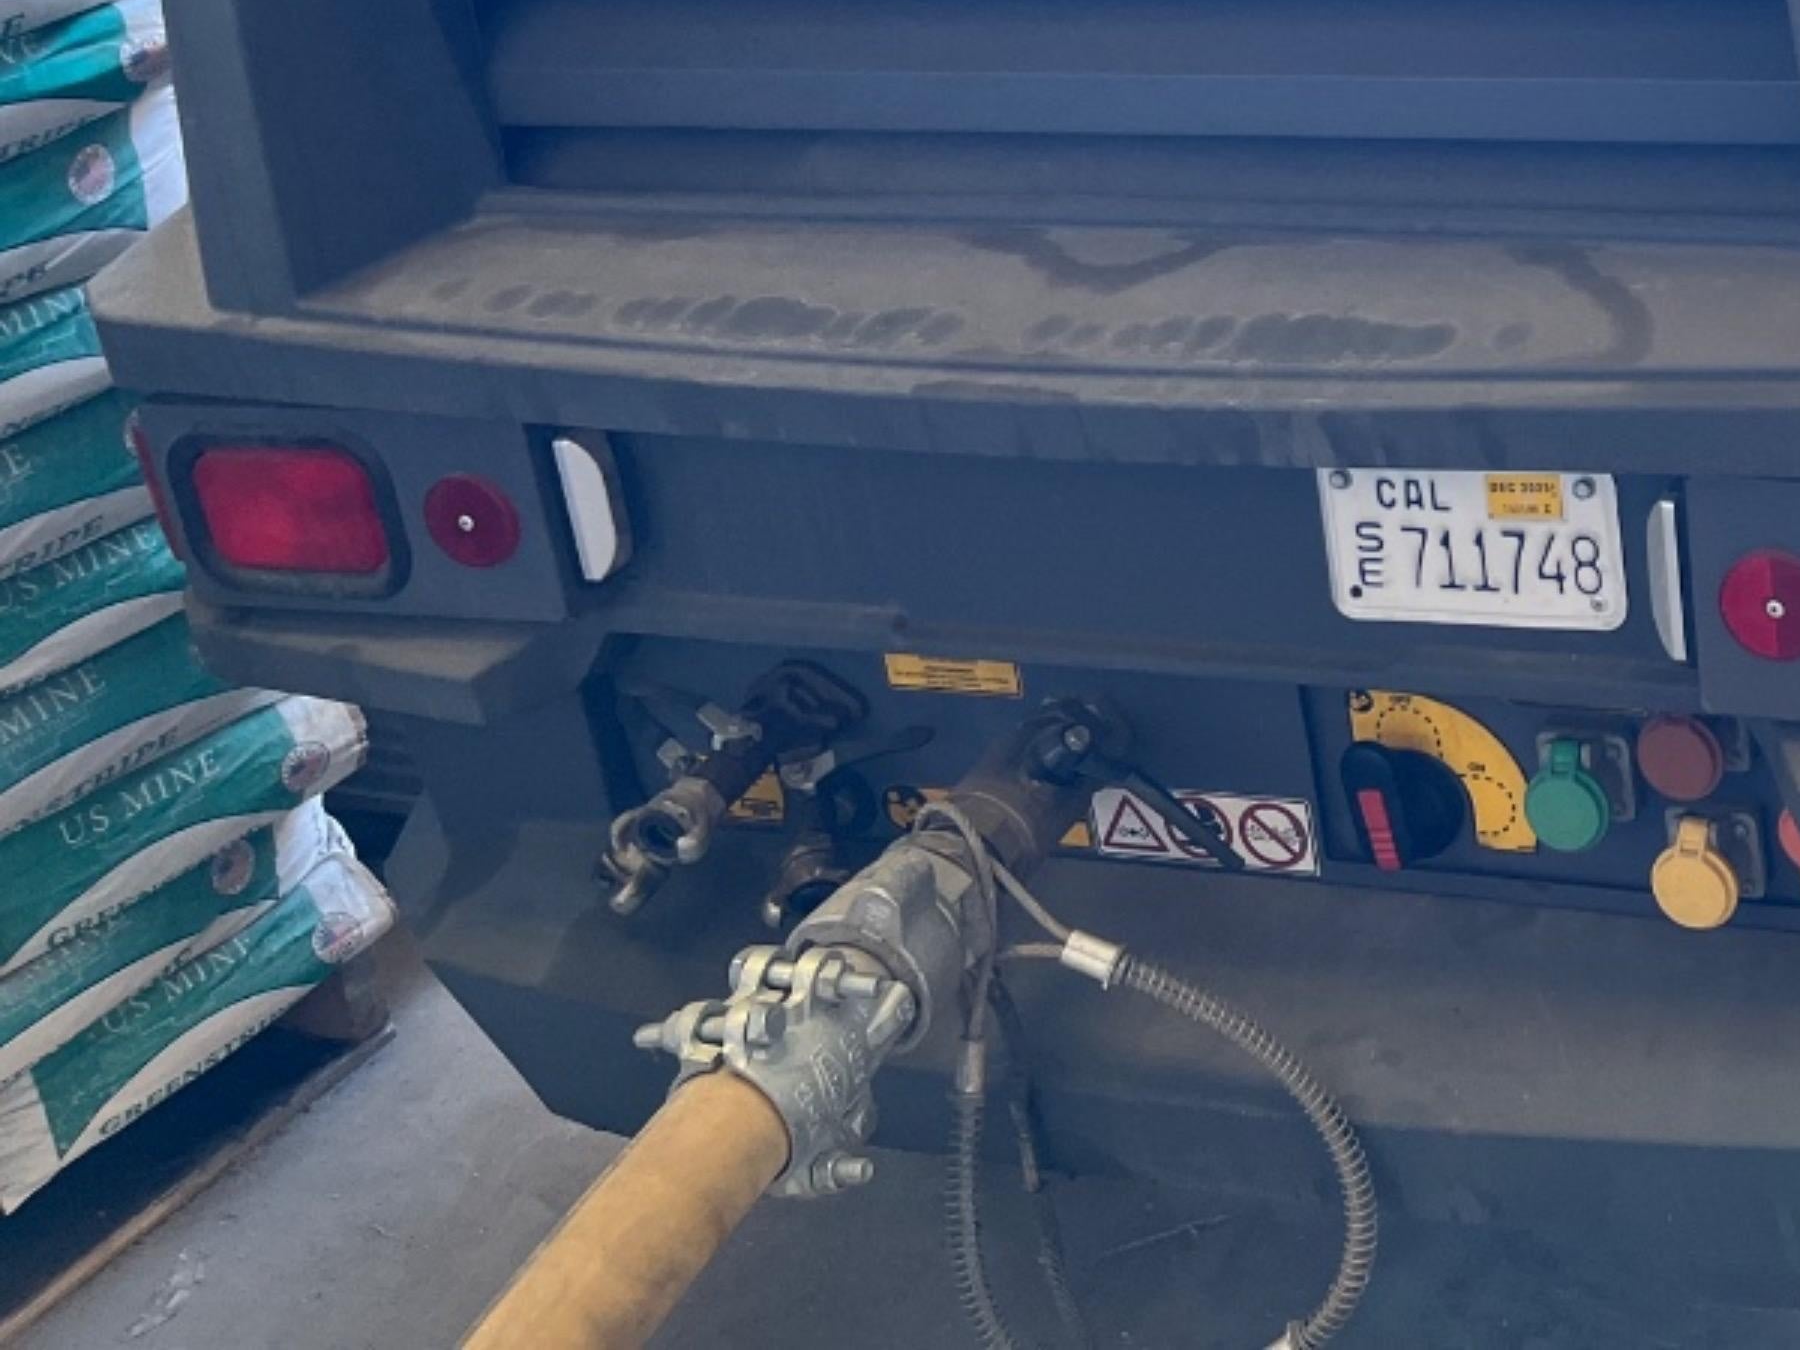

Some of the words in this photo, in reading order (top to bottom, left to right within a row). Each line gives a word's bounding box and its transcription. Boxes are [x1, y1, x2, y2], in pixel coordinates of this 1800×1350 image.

[1376, 477, 1453, 512] CAL
[1400, 526, 1604, 595] 711748
[58, 804, 111, 846] US
[121, 749, 222, 818] MINE
